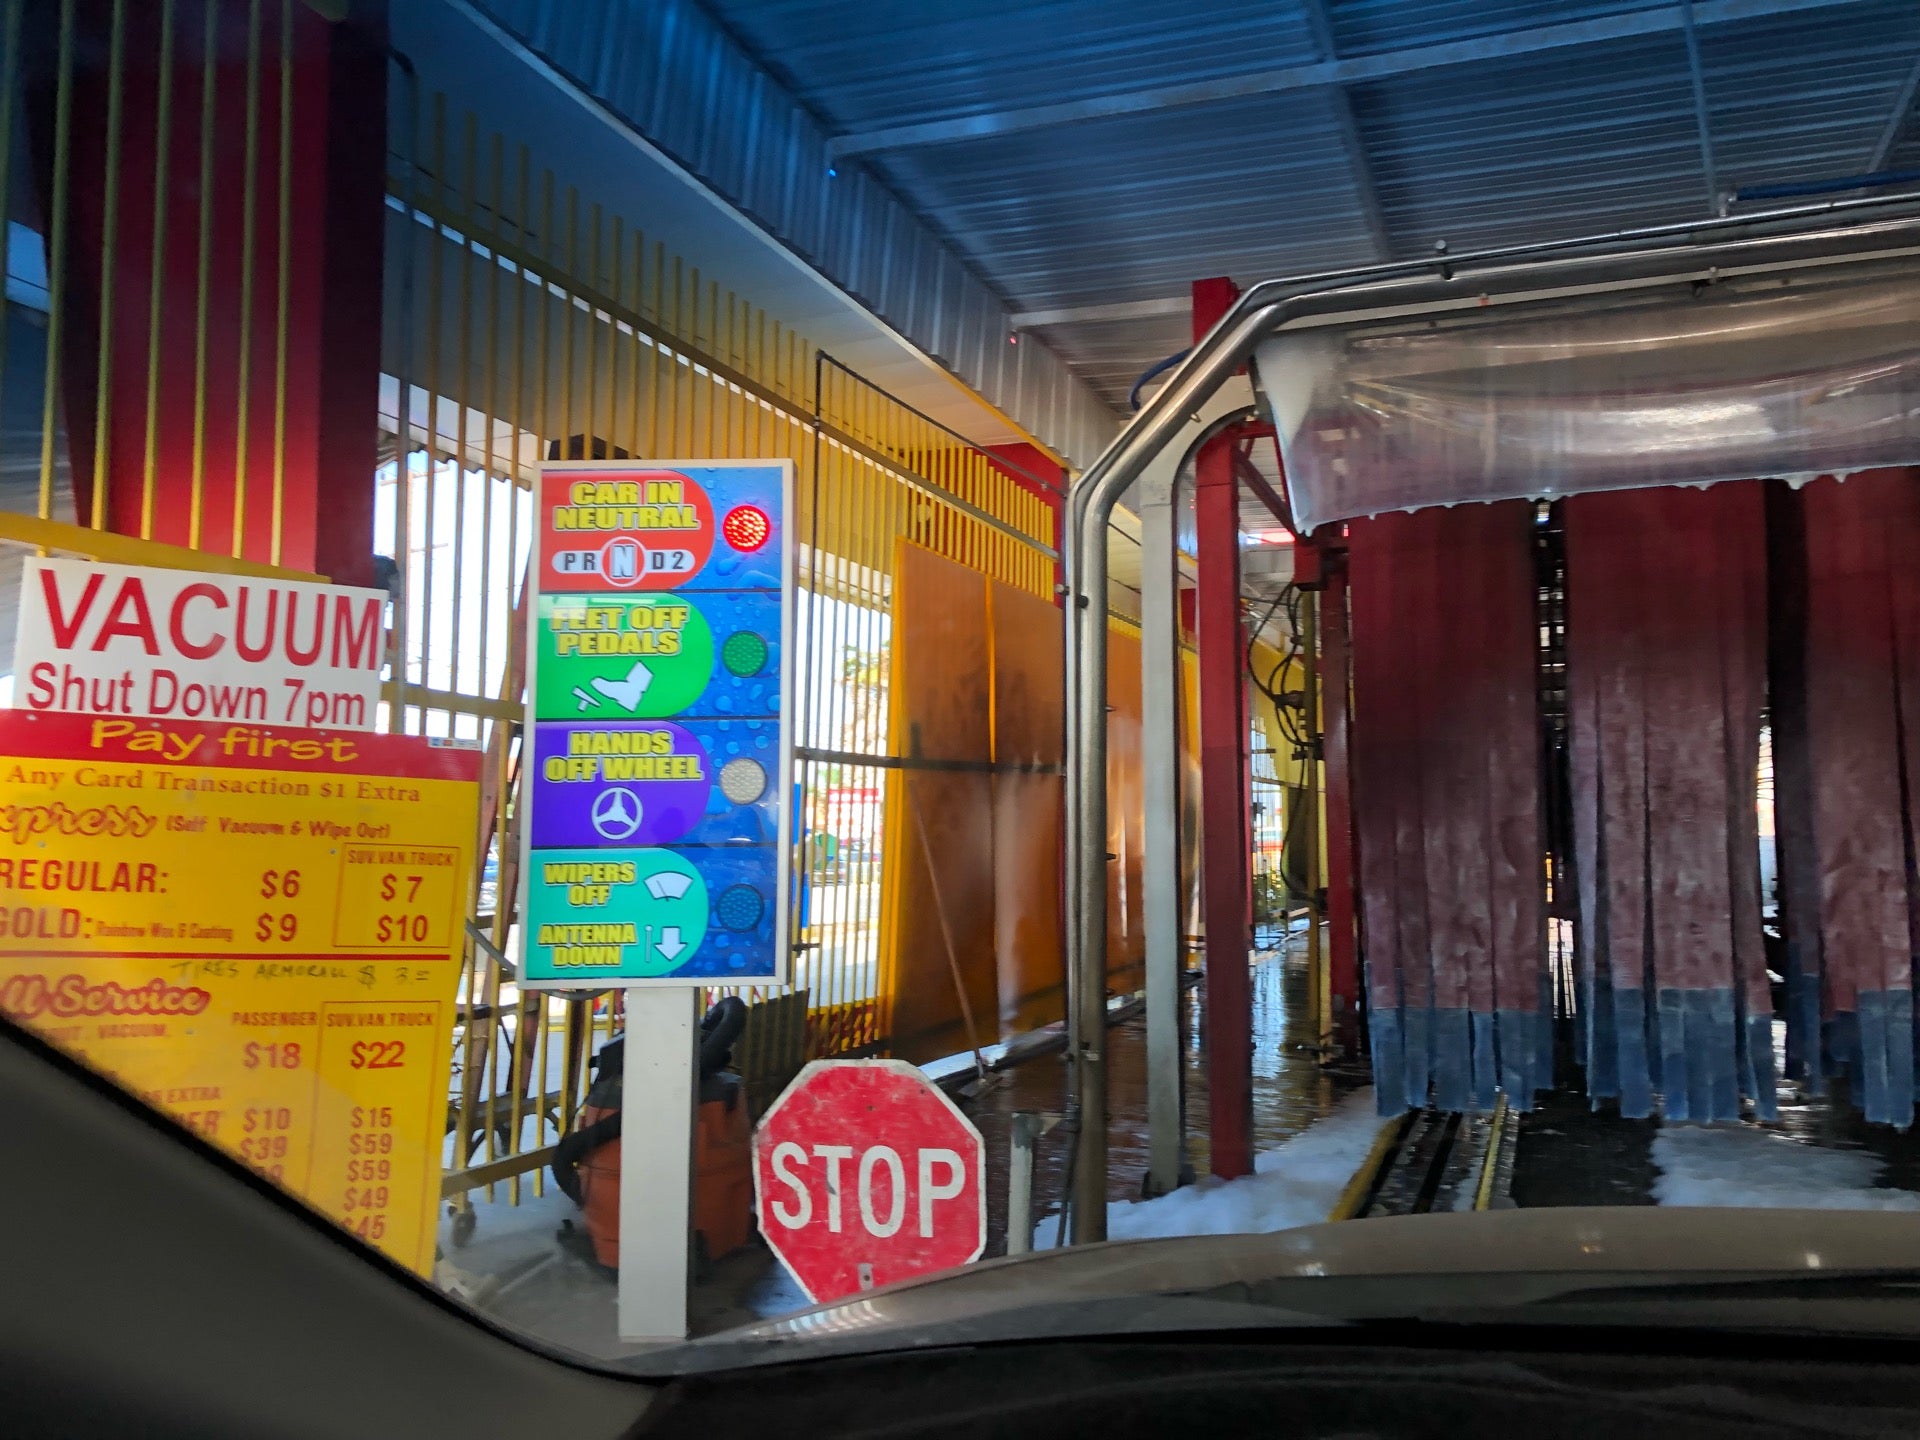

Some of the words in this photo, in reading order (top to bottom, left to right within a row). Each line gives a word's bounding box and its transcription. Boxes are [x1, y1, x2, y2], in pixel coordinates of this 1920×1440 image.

[570, 481, 640, 506] CAR
[646, 480, 683, 505] IN
[554, 505, 700, 531] NEUTRAL
[40, 569, 381, 671] VACUUM
[551, 606, 623, 631] FEET
[630, 605, 688, 630] OFF
[557, 631, 680, 656] PEDALS
[27, 662, 135, 713] Shut
[148, 669, 267, 719] Down
[284, 679, 365, 727] 7pm
[91, 719, 204, 761] Pay
[218, 727, 359, 762] first
[569, 730, 673, 755] HANDS
[544, 756, 599, 781] OFF
[602, 755, 704, 780] WHEEL
[6, 765, 64, 790] Any
[75, 767, 143, 788] Card
[153, 771, 309, 796] Transaction
[320, 782, 345, 798] $1
[357, 781, 421, 802] Extra
[309, 821, 352, 840] Wipe
[0, 858, 168, 893] REGULAR:
[261, 870, 301, 899] $6
[544, 861, 636, 884] WIPERS
[568, 885, 611, 906] OFF
[255, 912, 297, 943] $9
[376, 914, 428, 943] $10
[538, 923, 637, 945] ANTENNA
[553, 946, 621, 967] DOWN
[49, 974, 211, 1018] Service
[232, 1012, 317, 1026] PASSENGER
[243, 1040, 301, 1069] $18
[351, 1040, 405, 1069] $22
[243, 1108, 290, 1132] $10
[351, 1106, 392, 1128] $15
[349, 1133, 393, 1155] $59
[346, 1159, 391, 1182] $59
[343, 1186, 389, 1212] $49
[771, 1142, 966, 1238] STOP
